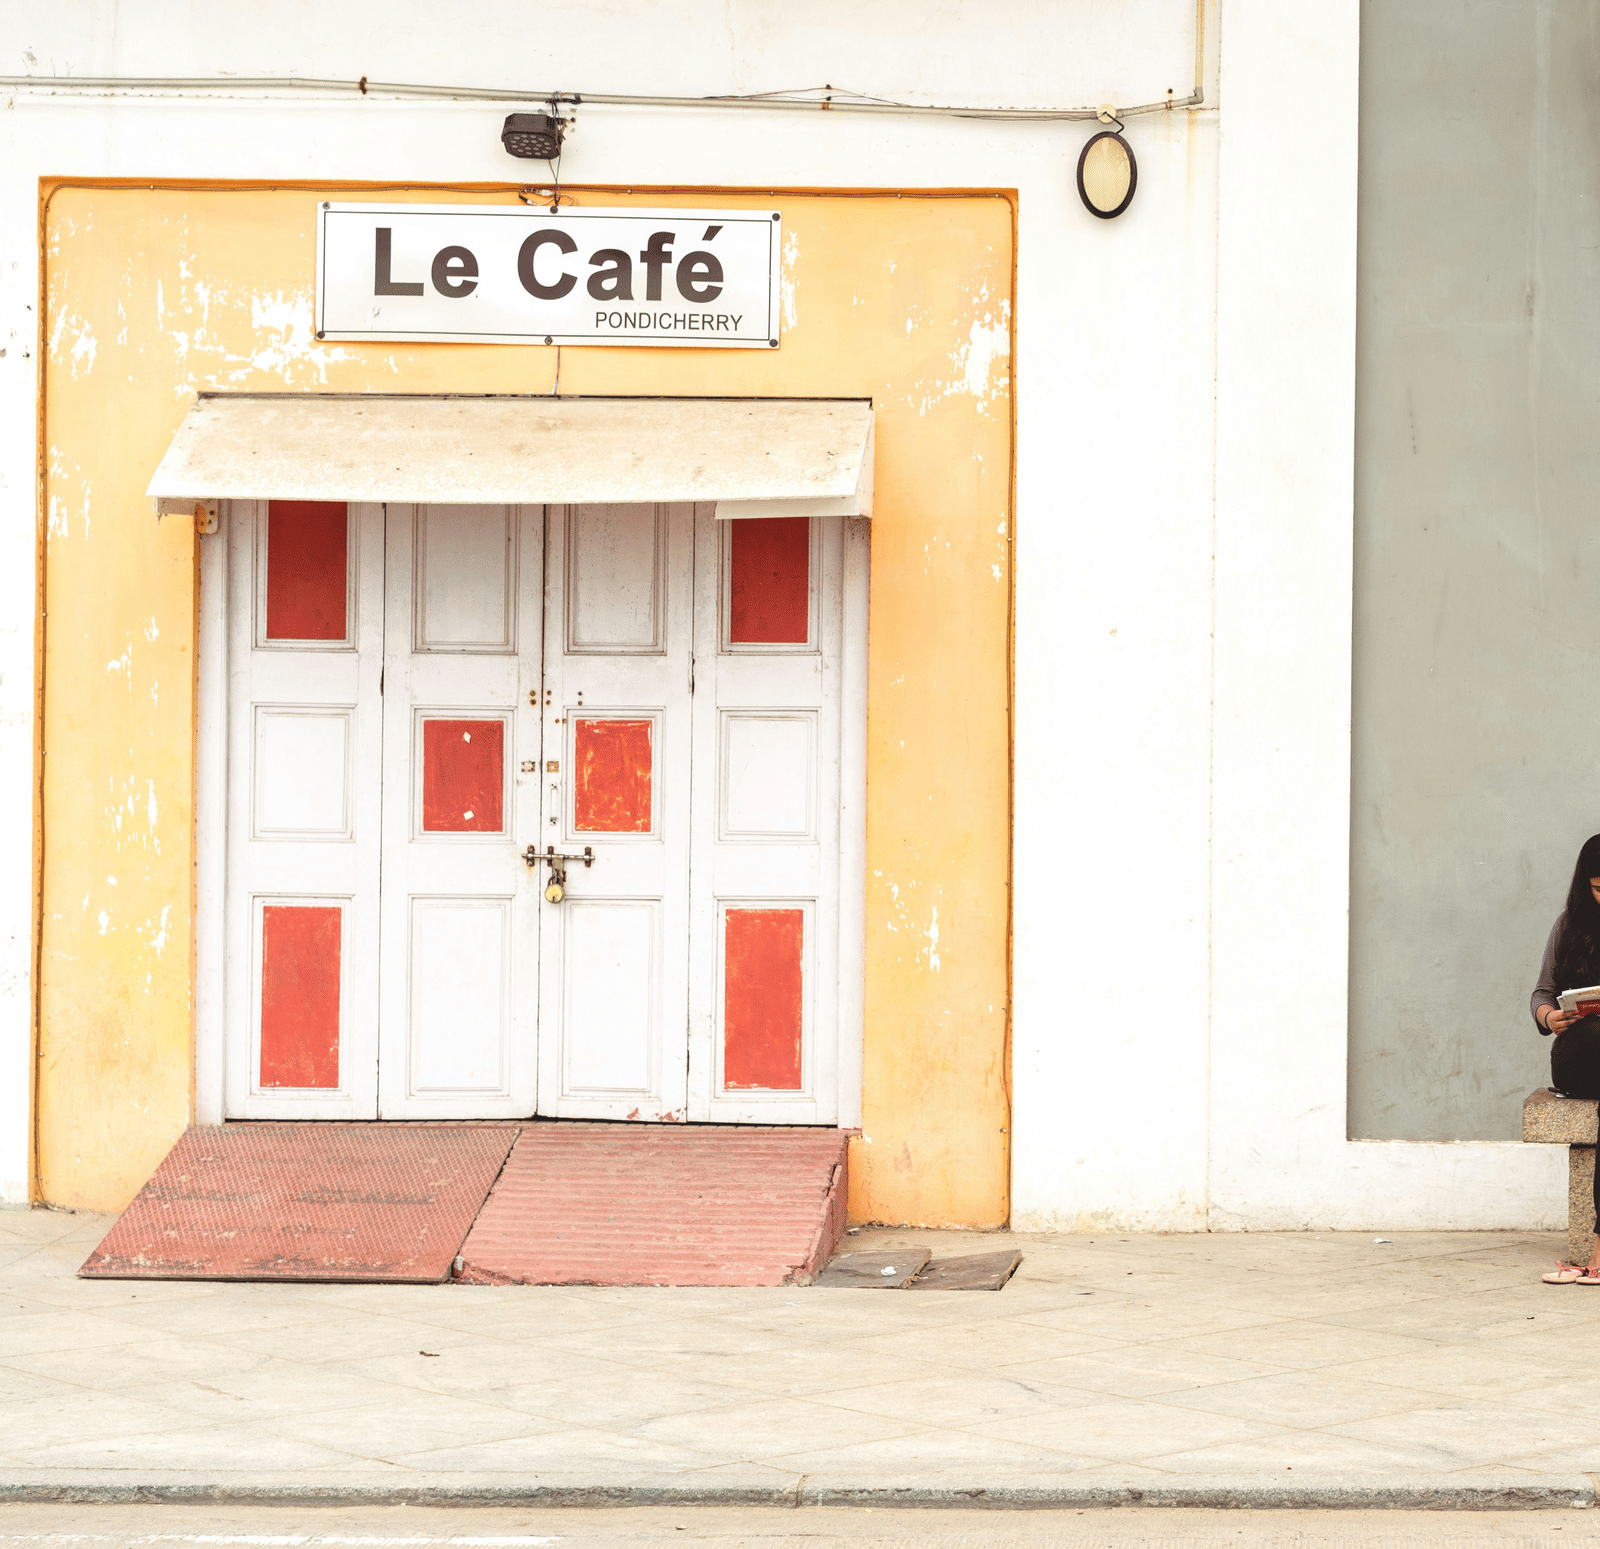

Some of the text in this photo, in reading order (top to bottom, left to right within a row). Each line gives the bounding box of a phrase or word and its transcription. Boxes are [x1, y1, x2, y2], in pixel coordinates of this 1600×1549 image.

[374, 225, 724, 304] Le Café
[595, 311, 743, 331] PONDICHERRY
